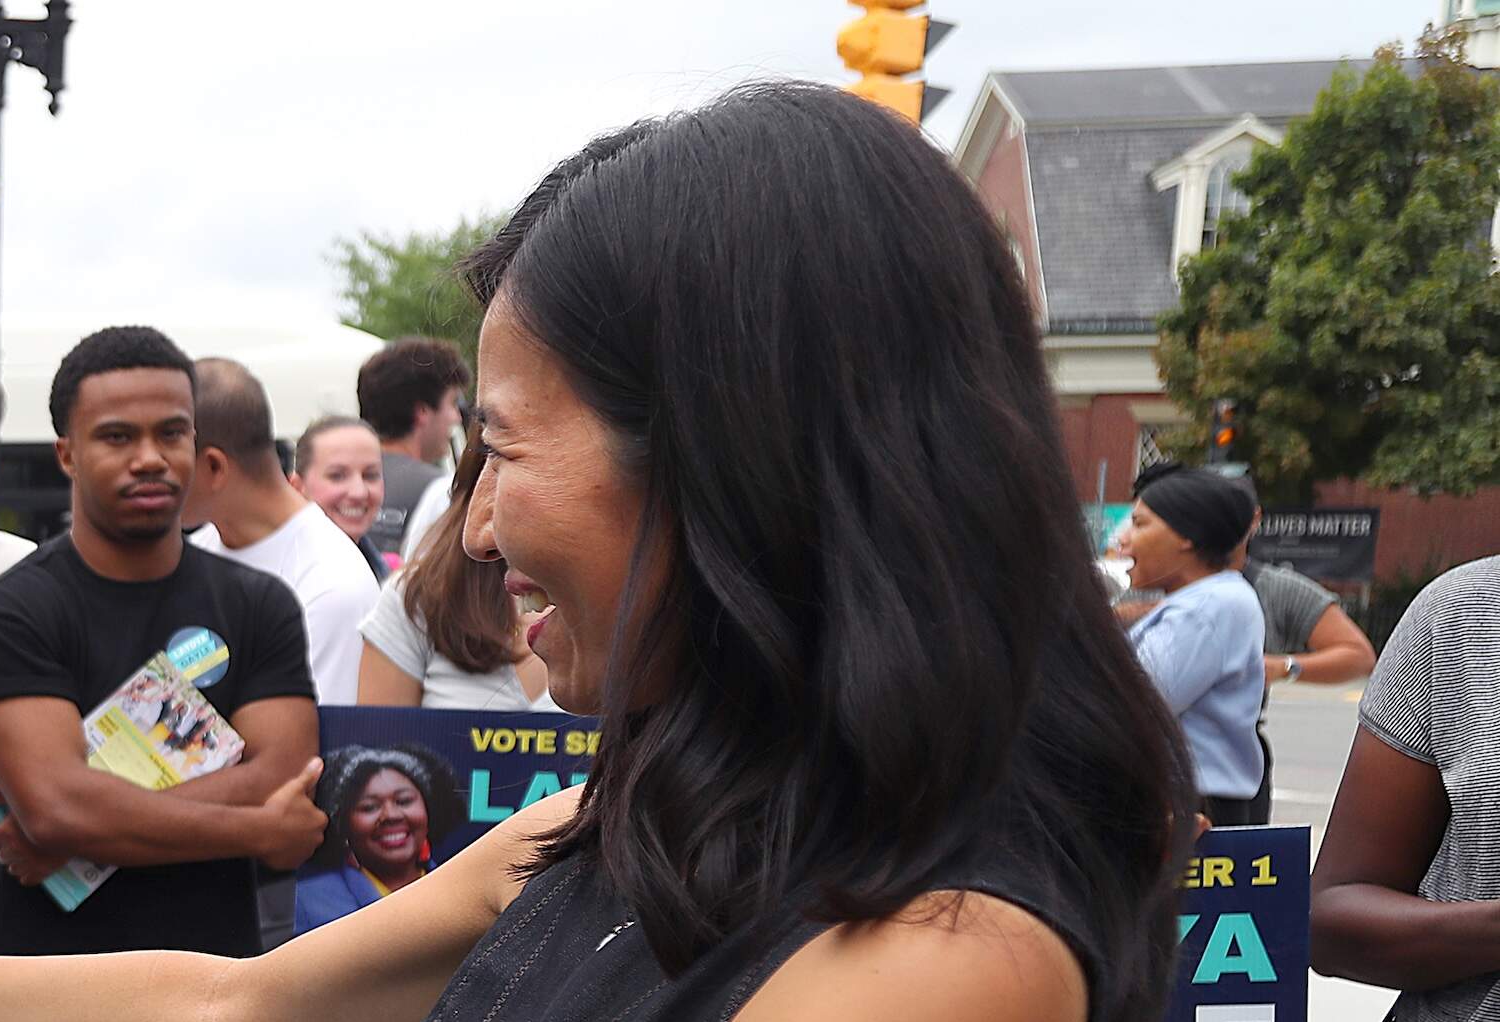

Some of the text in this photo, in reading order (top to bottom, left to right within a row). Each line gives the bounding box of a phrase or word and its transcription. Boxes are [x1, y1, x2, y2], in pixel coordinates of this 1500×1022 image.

[1308, 513, 1372, 537] MATTER
[471, 727, 558, 755] VOTE
[1251, 854, 1278, 886] 1
